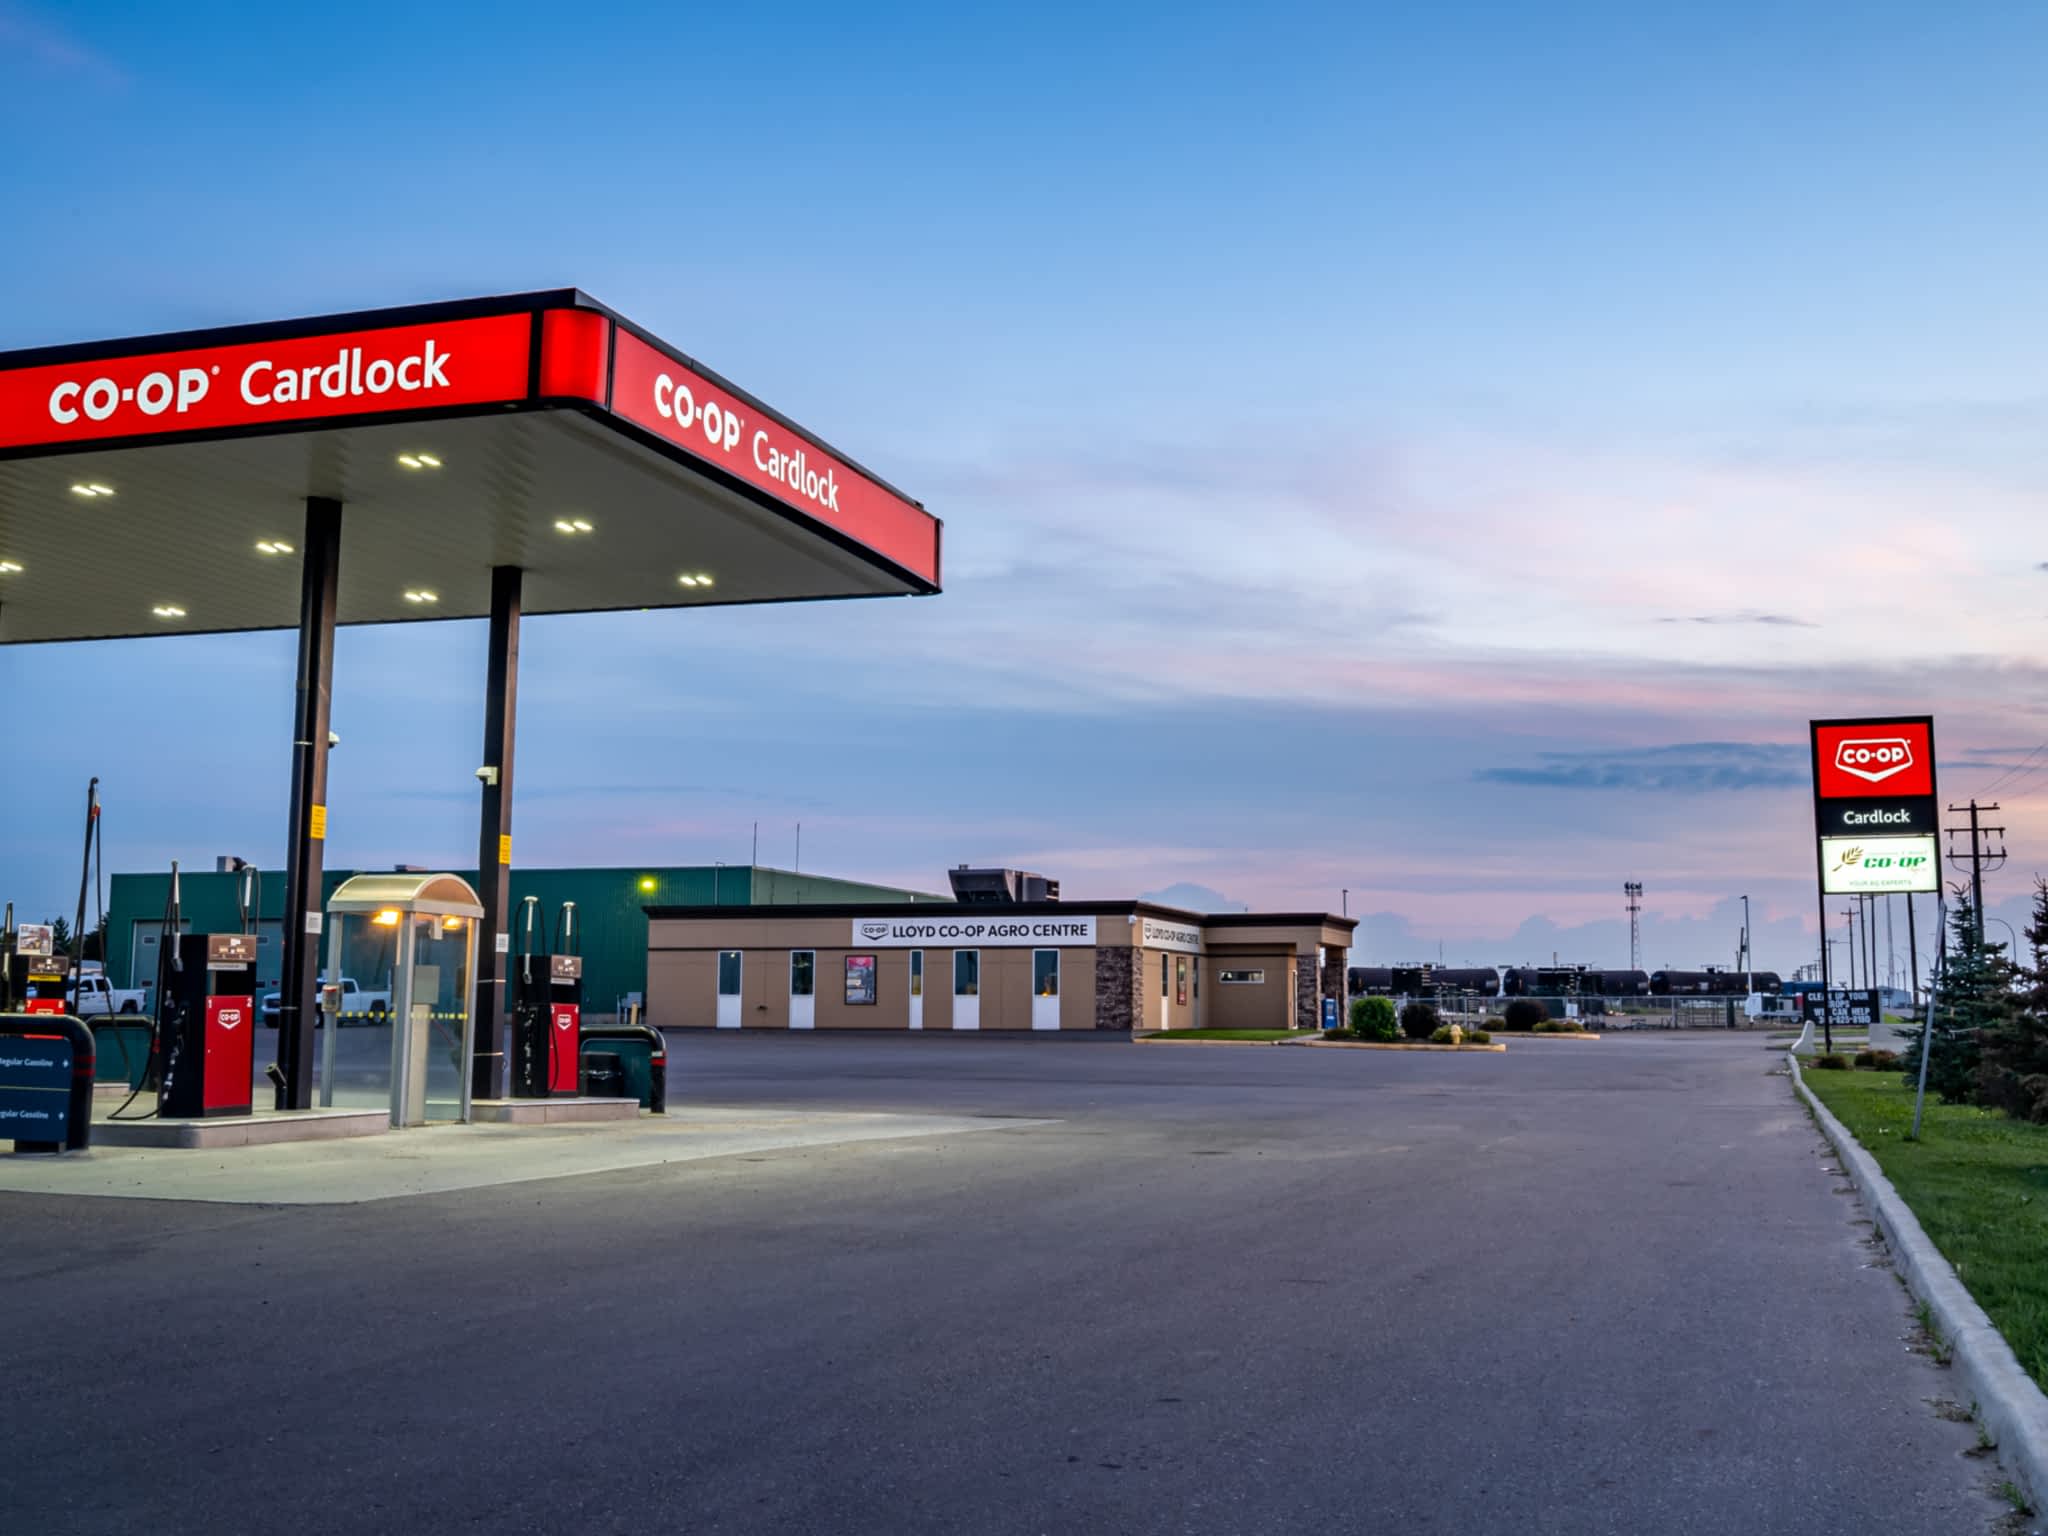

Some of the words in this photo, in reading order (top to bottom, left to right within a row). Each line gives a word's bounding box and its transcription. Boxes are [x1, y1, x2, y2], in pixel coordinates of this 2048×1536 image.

[48, 367, 210, 425] CO-OP
[240, 339, 451, 406] Cardlock
[654, 373, 740, 453] CO-OP
[753, 430, 840, 513] Cardlock
[1843, 808, 1911, 825] Cardlock
[892, 925, 936, 938] LLOYD
[938, 924, 986, 938] CO-OP
[987, 924, 1030, 937] AGRO
[1032, 923, 1088, 937] CENTRE
[1835, 992, 1845, 1000] UP
[1848, 992, 1869, 1000] YOUR
[1832, 1008, 1848, 1016] CAN
[1851, 1008, 1871, 1016] HELP
